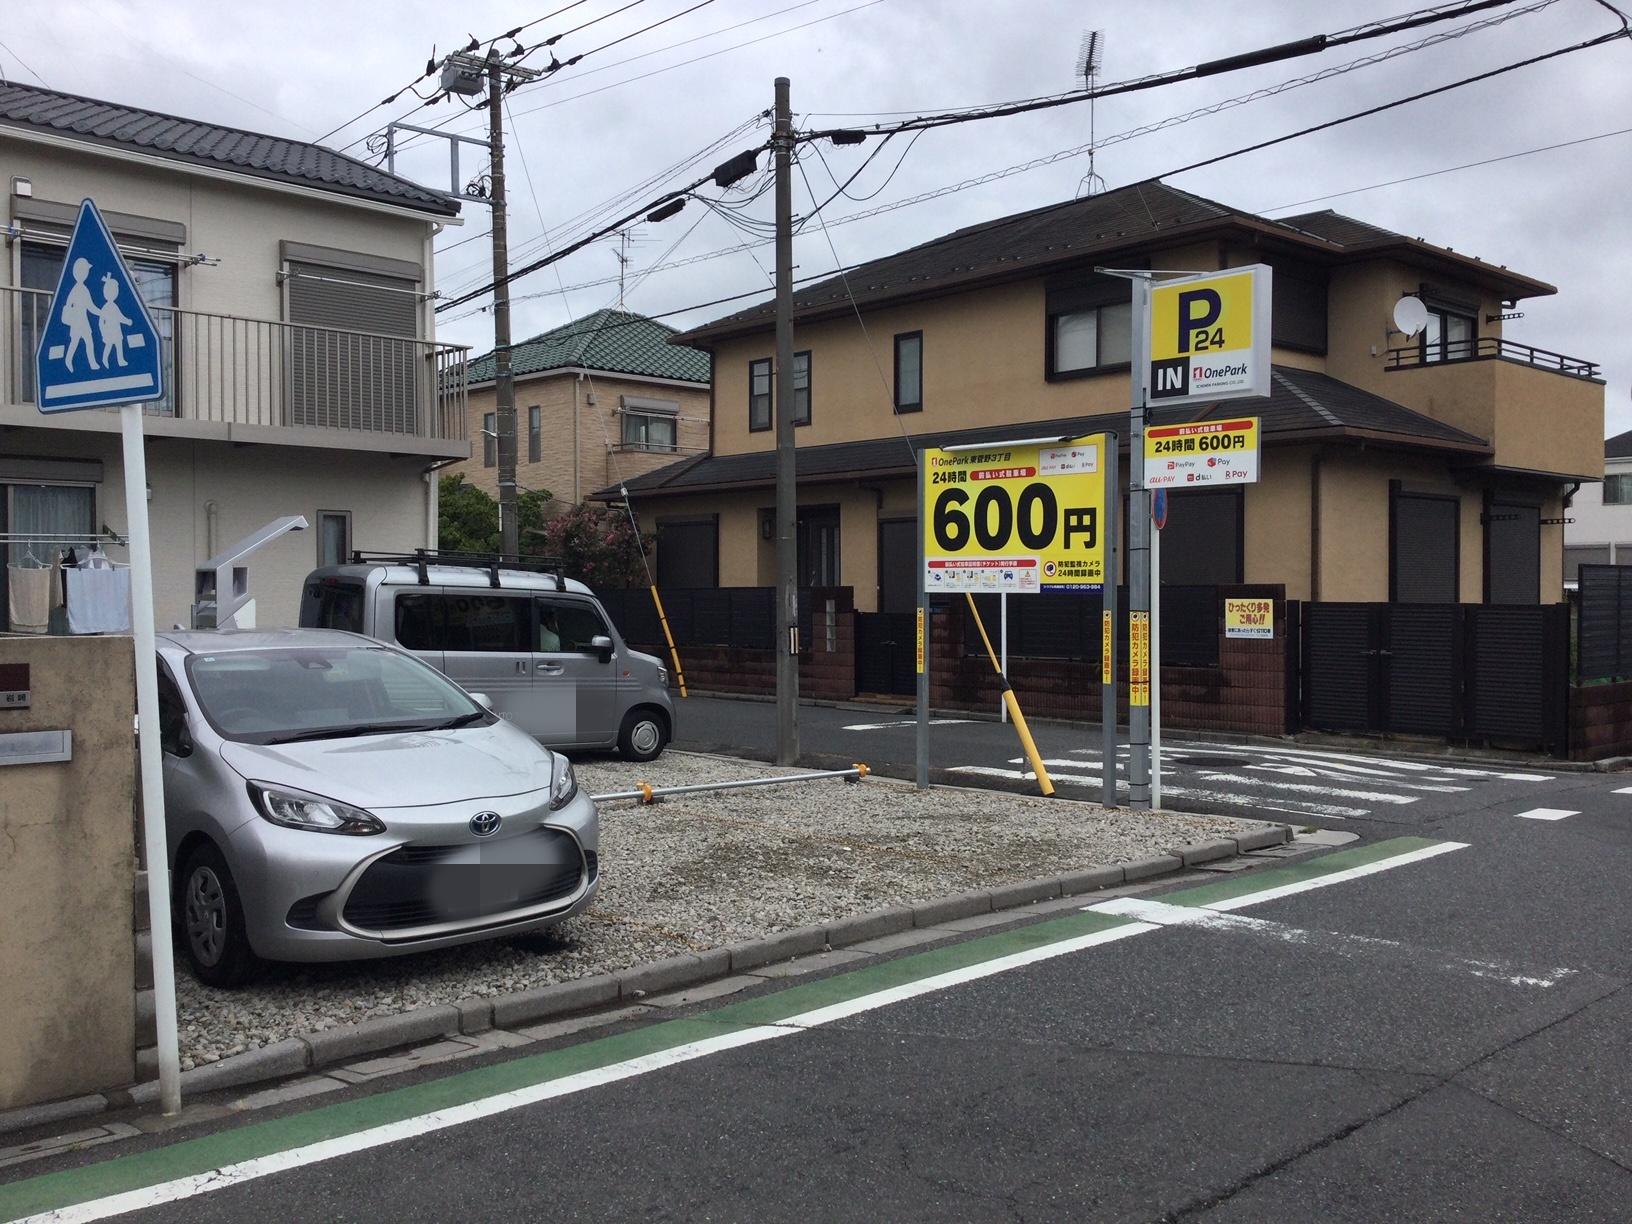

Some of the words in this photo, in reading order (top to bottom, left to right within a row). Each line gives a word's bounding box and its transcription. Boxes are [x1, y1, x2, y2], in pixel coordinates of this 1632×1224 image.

[1178, 288, 1222, 354] P
[1194, 327, 1225, 351] 24
[1157, 366, 1183, 391] IN
[1204, 363, 1248, 379] OnePark
[1155, 438, 1195, 453] 24時間
[1199, 434, 1245, 451] 600円
[1217, 458, 1231, 467] Pay
[932, 470, 967, 484] 24時間
[933, 482, 1097, 552] 600円
[1057, 560, 1101, 568] 防犯監視カメラ
[1057, 569, 1101, 577] 24時間録画中
[1228, 602, 1270, 613] ひったくり多発
